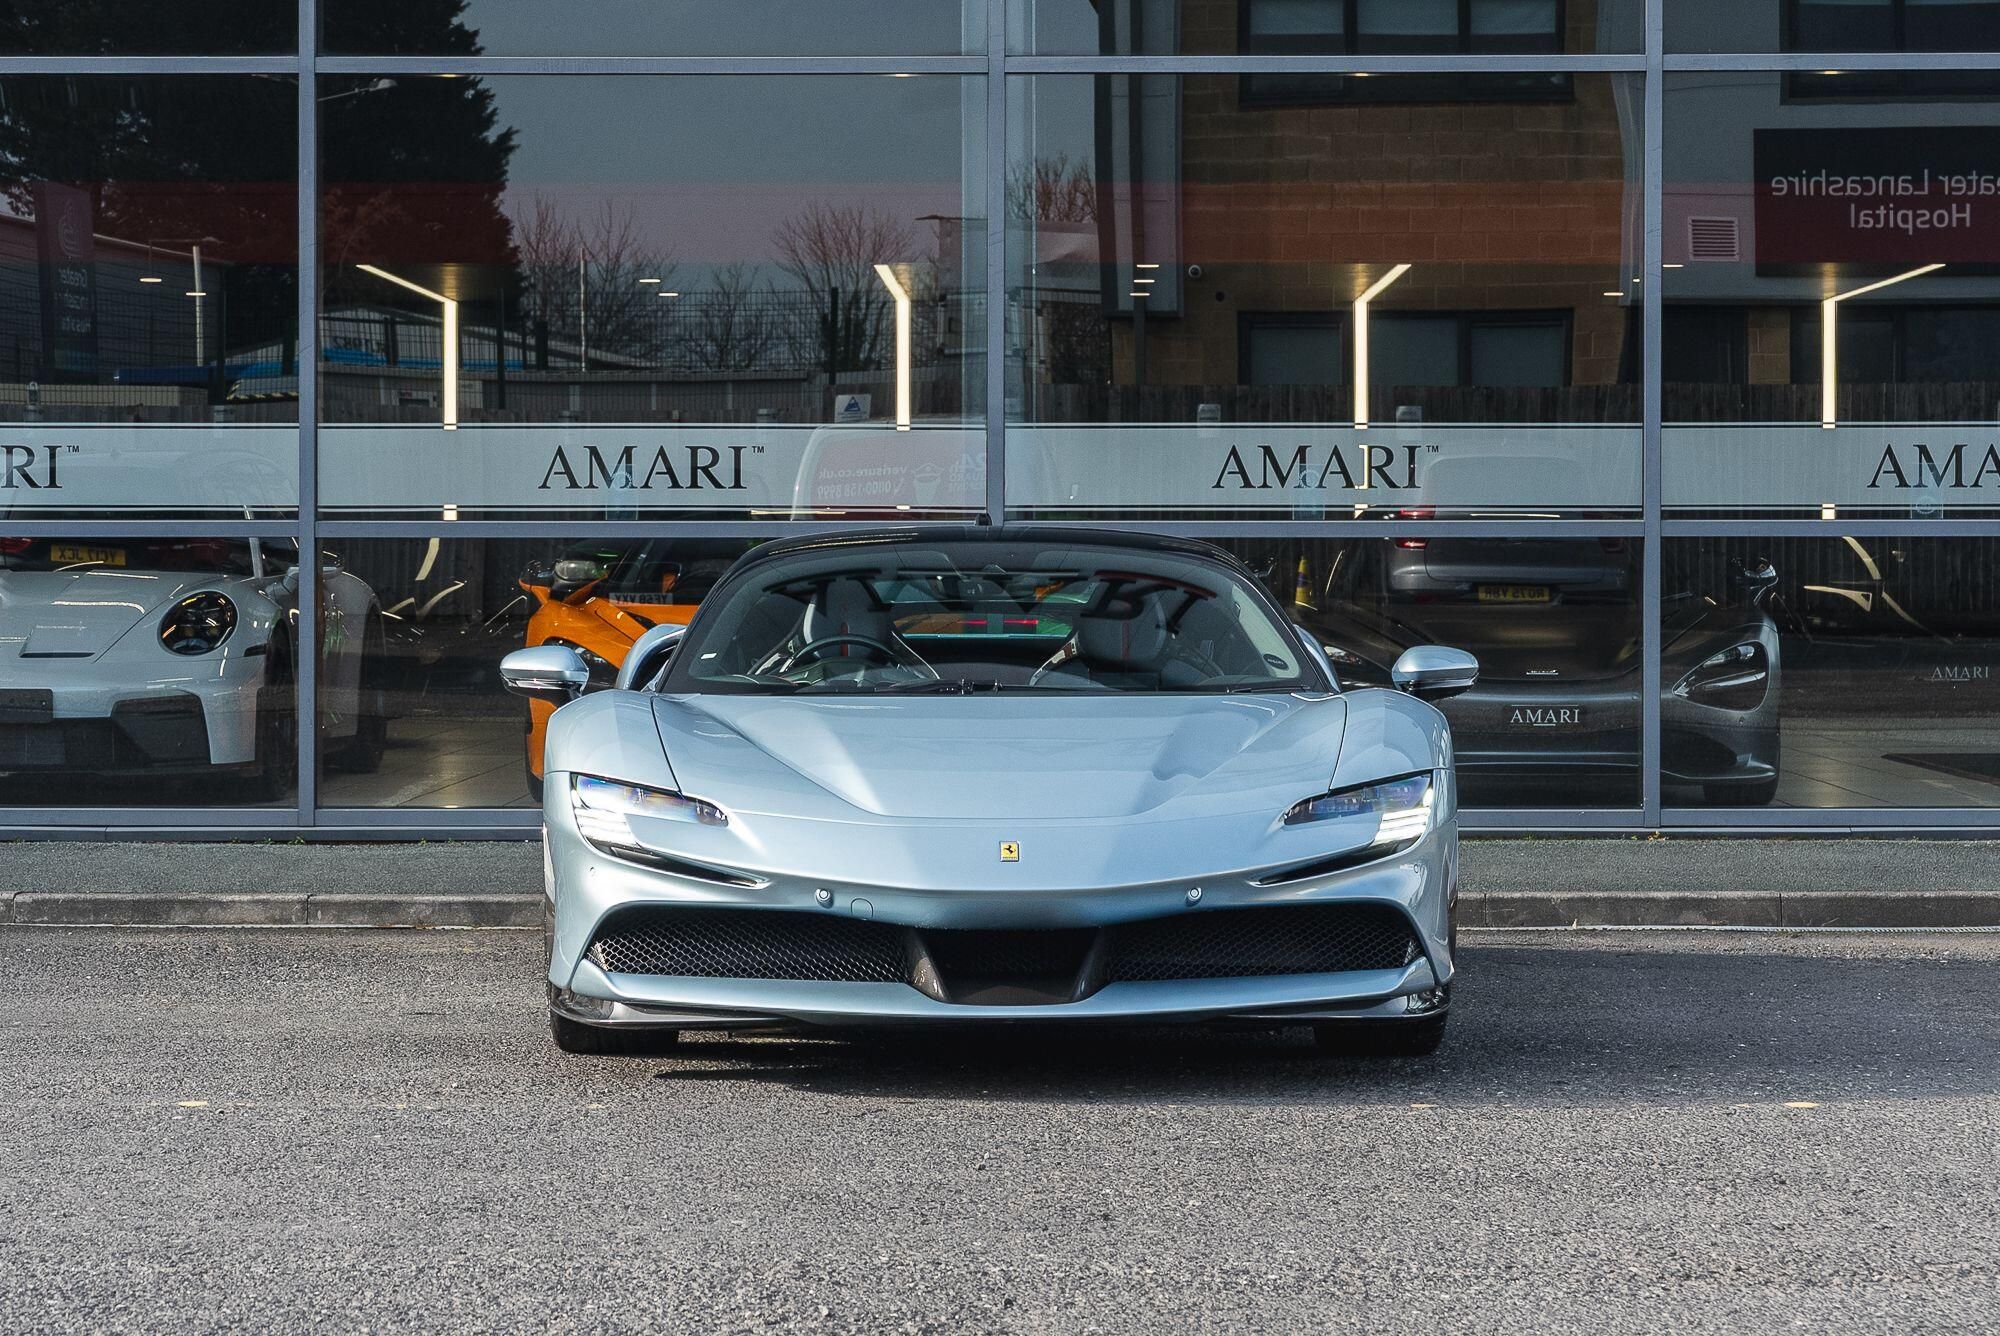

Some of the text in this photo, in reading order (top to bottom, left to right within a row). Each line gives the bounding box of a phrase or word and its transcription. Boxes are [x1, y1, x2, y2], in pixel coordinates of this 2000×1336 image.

[0, 445, 63, 489] RI
[537, 445, 748, 489] AMARI
[1211, 444, 1421, 489] AMARI
[1932, 666, 1989, 679] AMARI
[1510, 709, 1580, 723] AMARI
